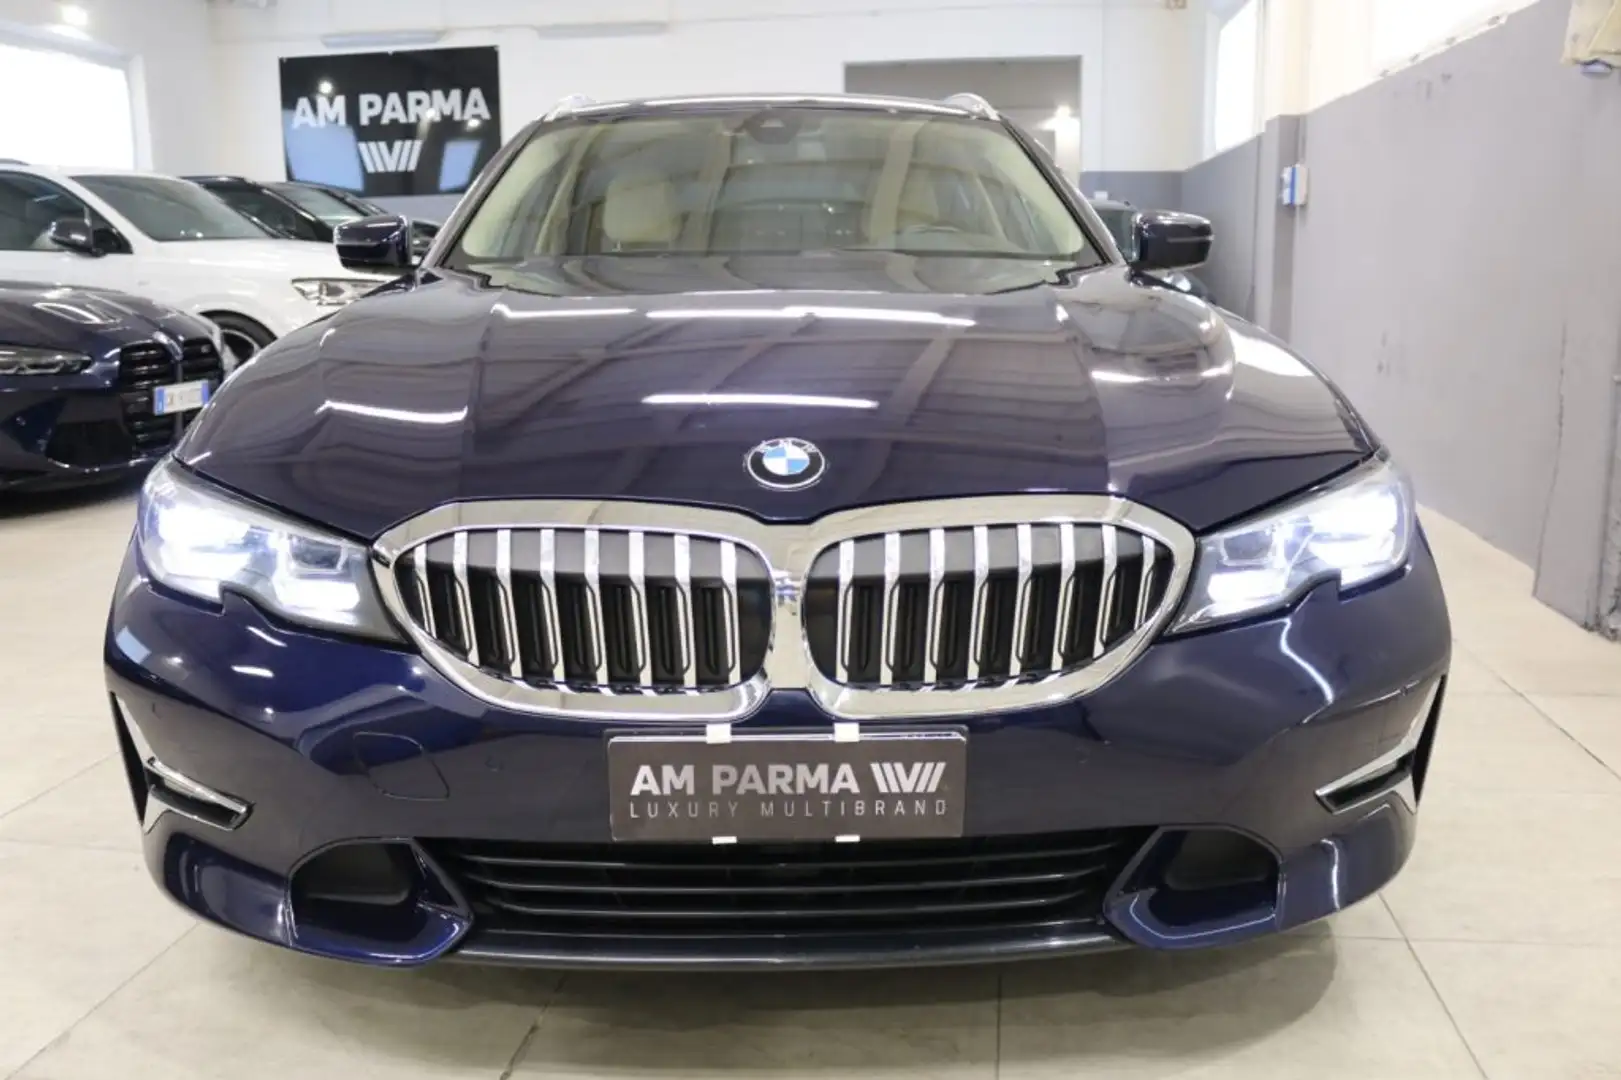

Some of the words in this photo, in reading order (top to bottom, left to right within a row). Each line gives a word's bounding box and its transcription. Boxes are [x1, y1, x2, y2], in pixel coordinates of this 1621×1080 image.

[292, 94, 347, 129] AM
[359, 87, 491, 126] PARMA
[630, 764, 695, 796] AM
[712, 763, 860, 795] PARMA
[630, 801, 738, 818] LUXURY
[760, 800, 947, 817] MULTIBRAND
